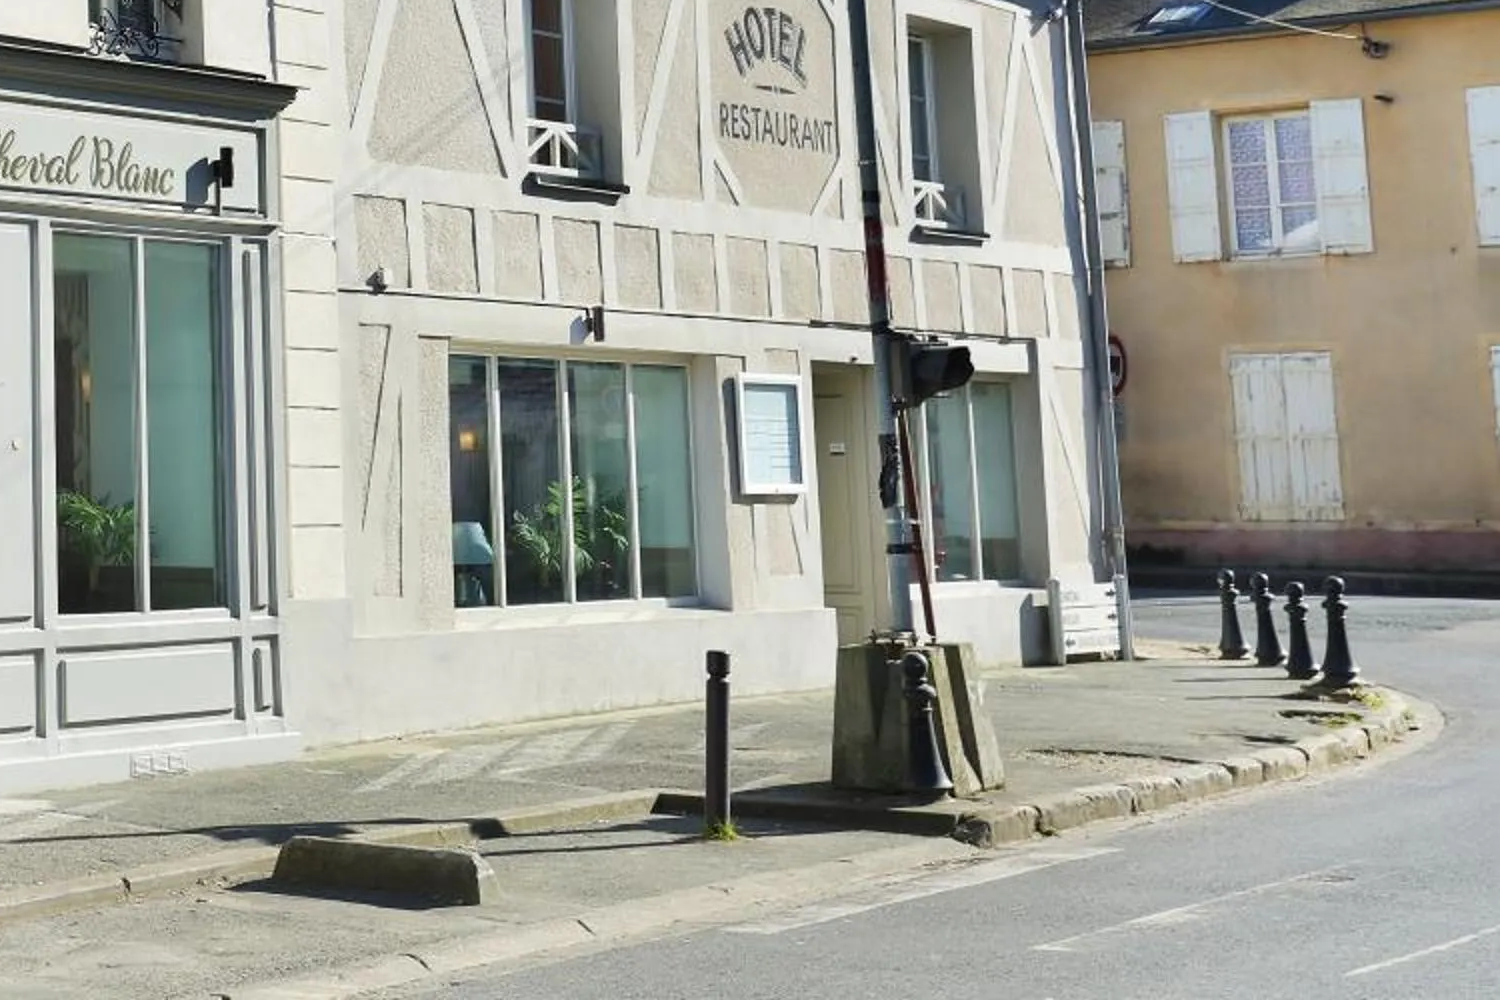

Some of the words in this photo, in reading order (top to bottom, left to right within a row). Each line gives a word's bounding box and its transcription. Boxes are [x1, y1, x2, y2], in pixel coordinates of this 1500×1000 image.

[724, 6, 807, 88] HOTEL
[719, 102, 833, 153] RESTAURANT
[89, 136, 175, 196] Blanc
